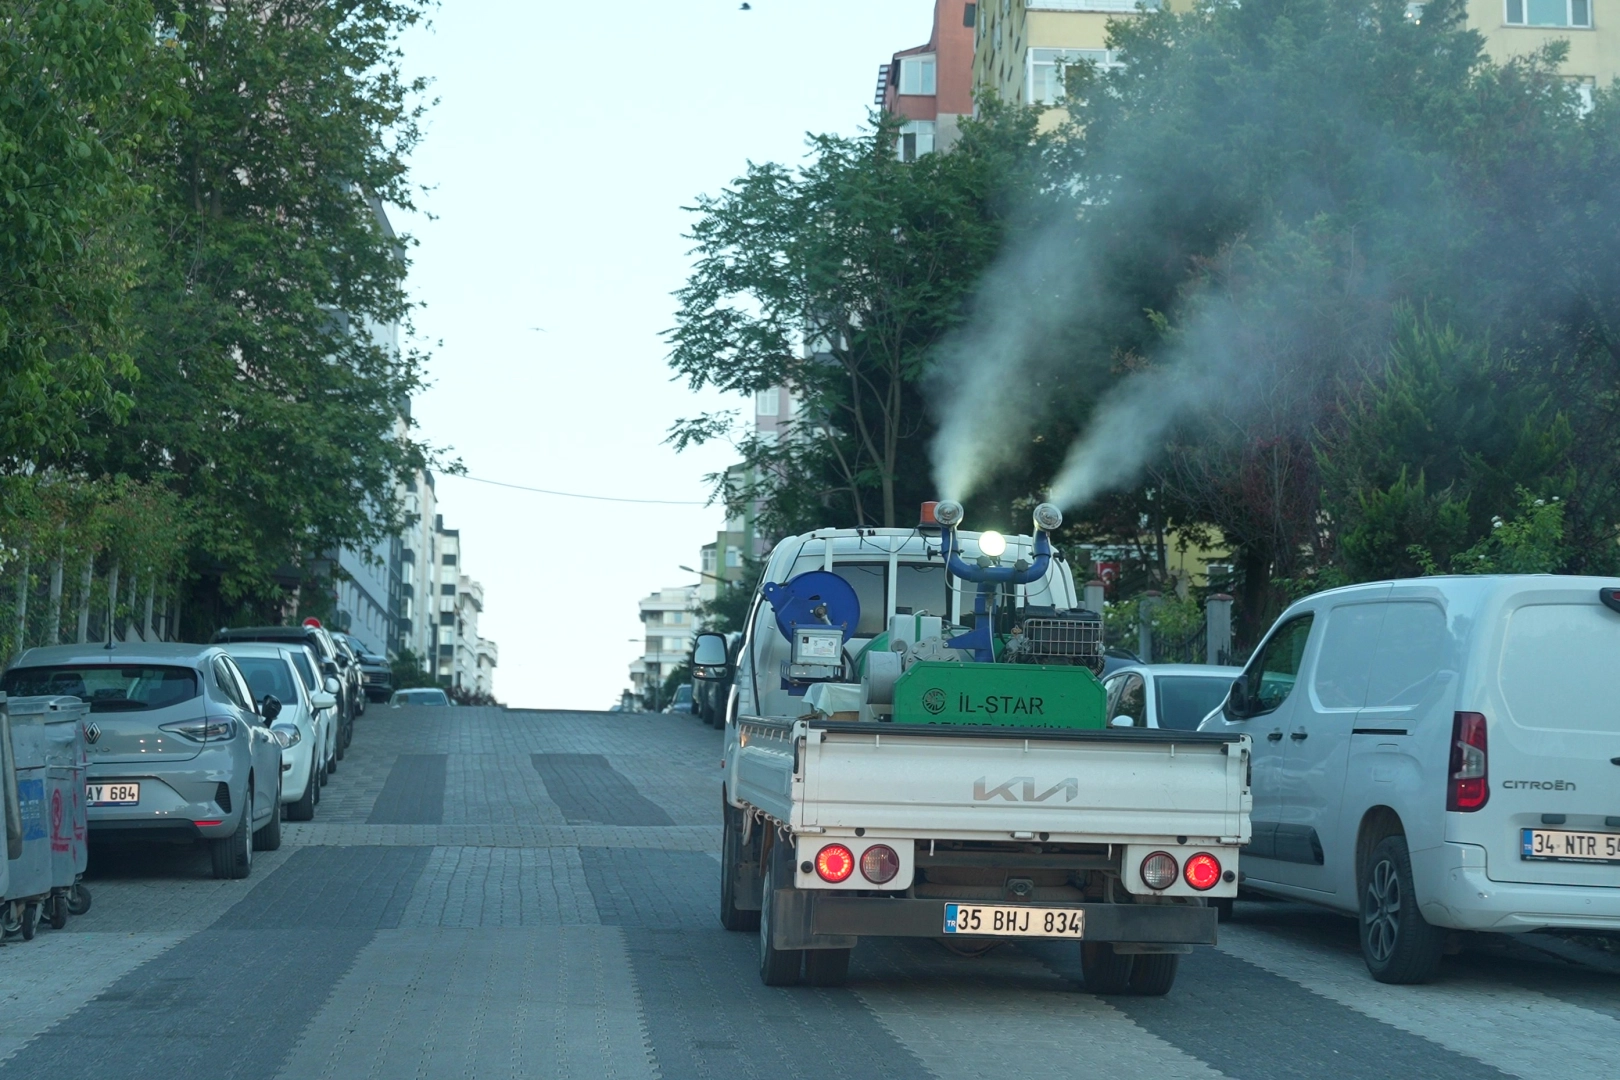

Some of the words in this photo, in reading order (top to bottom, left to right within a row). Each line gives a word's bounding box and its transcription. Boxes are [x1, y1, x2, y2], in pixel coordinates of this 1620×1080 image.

[959, 692, 1044, 715] İL-STAR
[110, 786, 136, 801] 684
[973, 776, 1079, 803] KIA
[1534, 833, 1555, 854] 34
[1565, 835, 1597, 856] NTR
[1606, 837, 1620, 857] 5
[946, 919, 956, 928] TR
[957, 909, 982, 931] 35
[993, 910, 1030, 932] BHJ
[1043, 912, 1080, 934] 834
